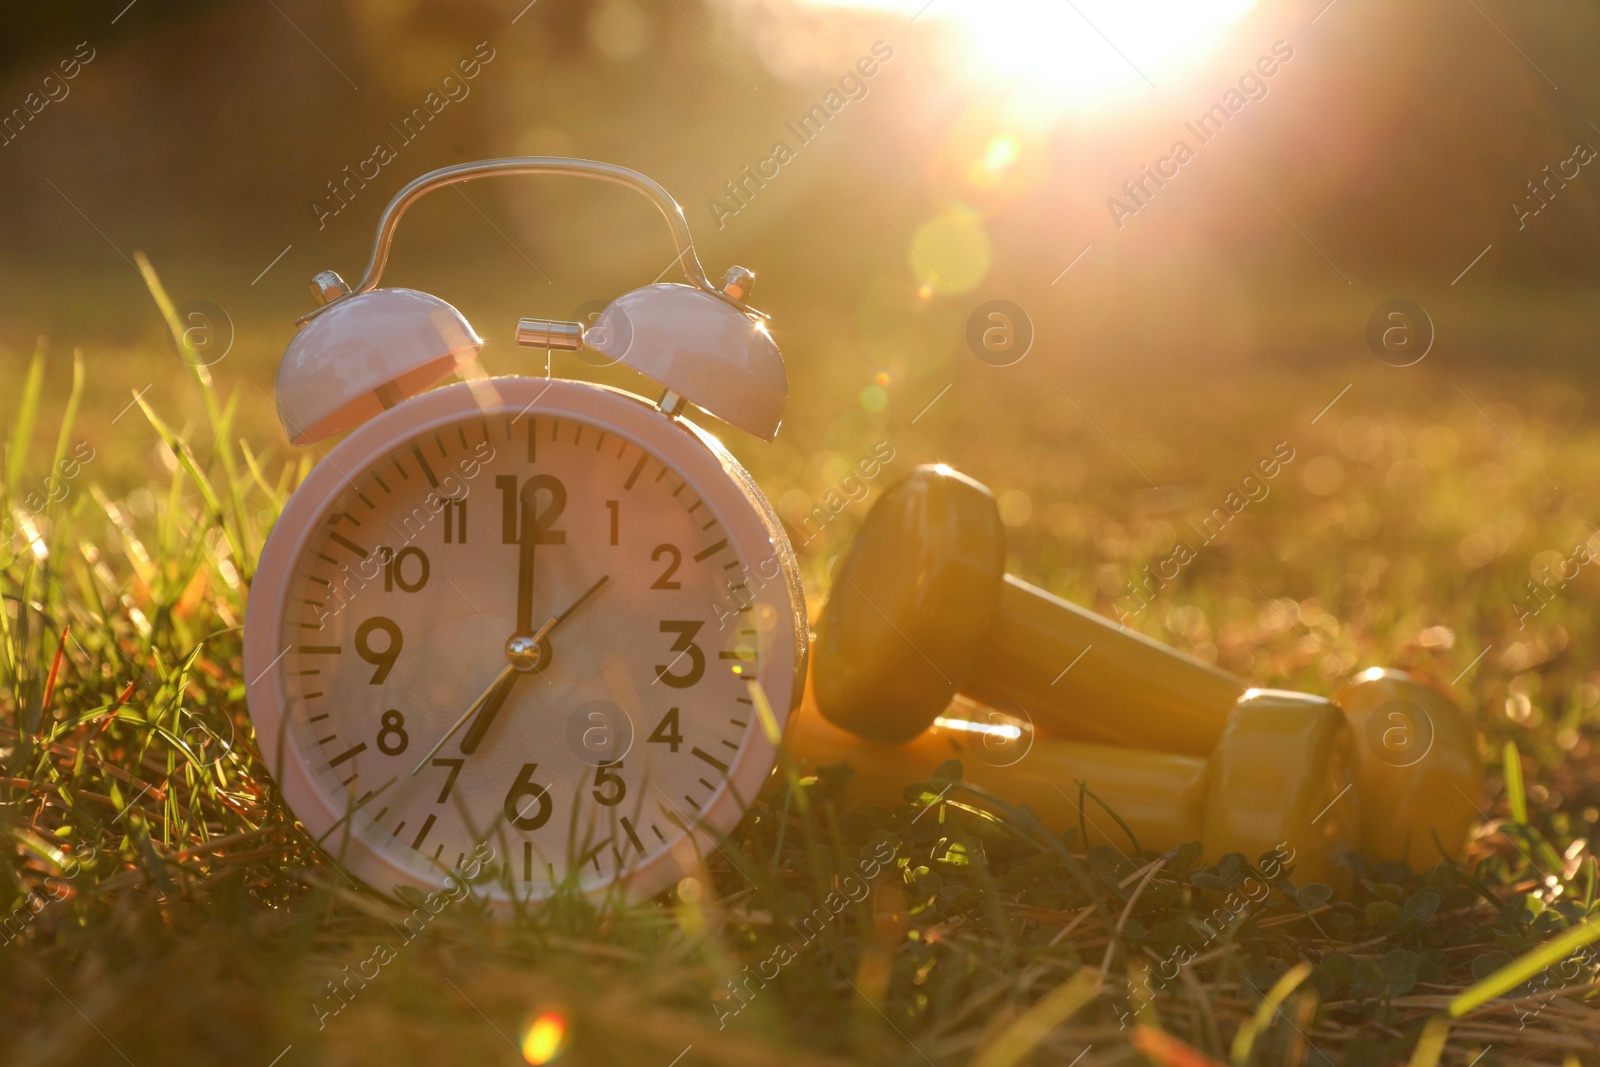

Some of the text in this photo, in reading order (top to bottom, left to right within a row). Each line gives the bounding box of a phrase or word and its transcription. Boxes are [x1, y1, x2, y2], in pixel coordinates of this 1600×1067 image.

[440, 498, 467, 544] 11
[496, 475, 567, 545] 12
[605, 500, 619, 546] 1
[380, 546, 430, 593] 10
[649, 544, 682, 590] 2
[354, 616, 403, 685] 9
[654, 620, 706, 689] 3
[376, 710, 409, 756] 8
[646, 707, 683, 753] 4
[432, 759, 466, 804] 7
[503, 763, 553, 831] 6
[592, 761, 627, 806] 5
